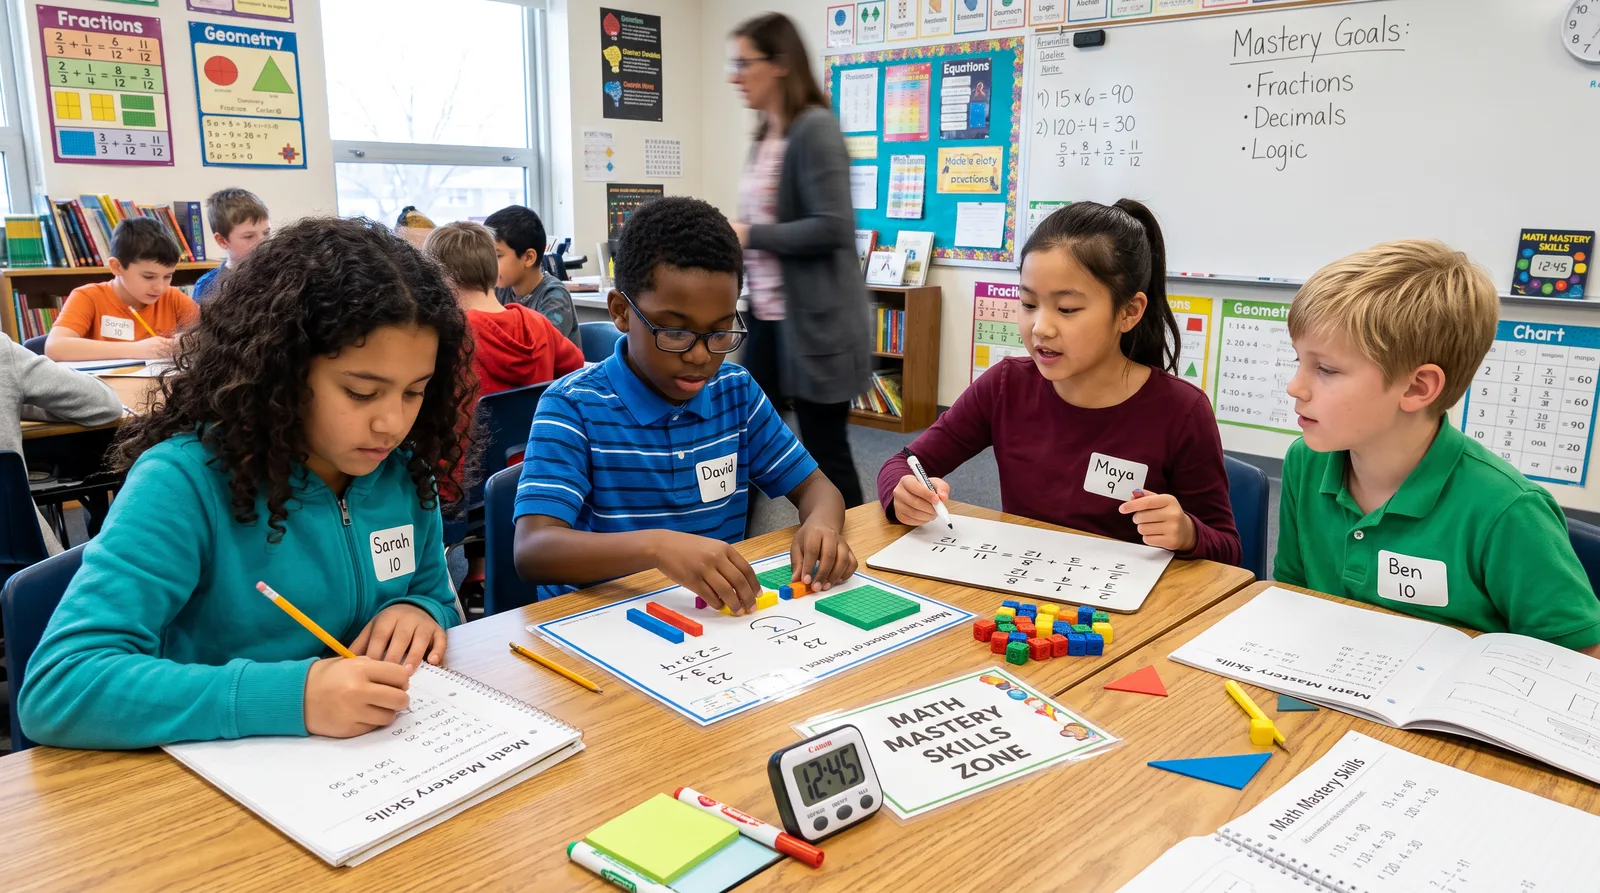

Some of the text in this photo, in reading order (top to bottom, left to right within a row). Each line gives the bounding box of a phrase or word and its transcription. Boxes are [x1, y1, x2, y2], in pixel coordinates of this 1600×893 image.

[1038, 4, 1055, 12] Logic
[1575, 4, 1588, 14] 10
[57, 10, 143, 34] Fractions
[1569, 19, 1577, 29] 9
[56, 32, 63, 41] 2
[112, 38, 118, 46] 6
[204, 26, 283, 50] Geometry
[1233, 14, 1410, 63] Mastery Goals:
[1571, 34, 1580, 44] 8
[57, 45, 64, 54] 3
[139, 40, 148, 49] 11
[1583, 43, 1591, 53] 7
[85, 48, 92, 56] 4
[111, 50, 122, 59] 12
[140, 52, 151, 61] 12
[59, 62, 65, 70] 2
[115, 66, 122, 75] 8
[144, 68, 150, 77] 3
[943, 62, 990, 76] Equations
[60, 74, 67, 83] 3
[88, 77, 95, 85] 4
[114, 79, 126, 87] 12
[143, 81, 154, 90] 12
[1256, 71, 1354, 97] Fractions
[1055, 89, 1071, 108] 15
[1111, 84, 1134, 104] 90
[1254, 102, 1346, 129] Decimals
[1036, 118, 1048, 138] 2)
[1053, 118, 1076, 136] 120
[1114, 115, 1136, 133] 30
[99, 133, 106, 142] 3
[126, 134, 132, 143] 3
[101, 145, 108, 154] 3
[125, 146, 136, 155] 12
[152, 148, 163, 156] 12
[1058, 139, 1140, 168] 5 3 8 12 3 12 11 12
[1251, 137, 1308, 171] Logic
[1522, 233, 1592, 244] MATH MASTERY
[1538, 242, 1570, 252] SKILLS
[1537, 261, 1567, 273] 12:45
[987, 284, 1020, 298] Fracti
[1233, 302, 1289, 318] Geometr
[114, 328, 123, 337] 10
[1513, 324, 1566, 343] Chart
[1484, 366, 1491, 376] 2
[1577, 375, 1593, 384] 60
[1481, 388, 1488, 396] 5
[1574, 398, 1589, 407] 60
[1478, 409, 1585, 430] 3 90
[1474, 430, 1581, 452] 10 20
[701, 458, 734, 481] David
[1094, 458, 1134, 483] Maya
[1564, 465, 1578, 474] 40
[719, 480, 727, 492] 9
[1107, 481, 1116, 494] 9
[373, 532, 410, 554] Sarah
[389, 557, 401, 573] 10
[1389, 557, 1423, 580] Ben
[1399, 582, 1416, 598] 10
[1215, 657, 1372, 700] Math Mastery Skills
[887, 697, 966, 729] MATH
[882, 705, 1004, 753] MASTERY
[485, 739, 530, 763] Math
[807, 740, 833, 753] Canon
[922, 726, 1012, 764] SKILLS
[950, 744, 1032, 780] ZONE
[416, 760, 487, 799] Mastery
[802, 747, 859, 801] 12:45
[1268, 809, 1305, 832] Math
[1296, 777, 1345, 811] Mastery
[1333, 758, 1366, 780] Skills
[364, 796, 416, 823] Skills
